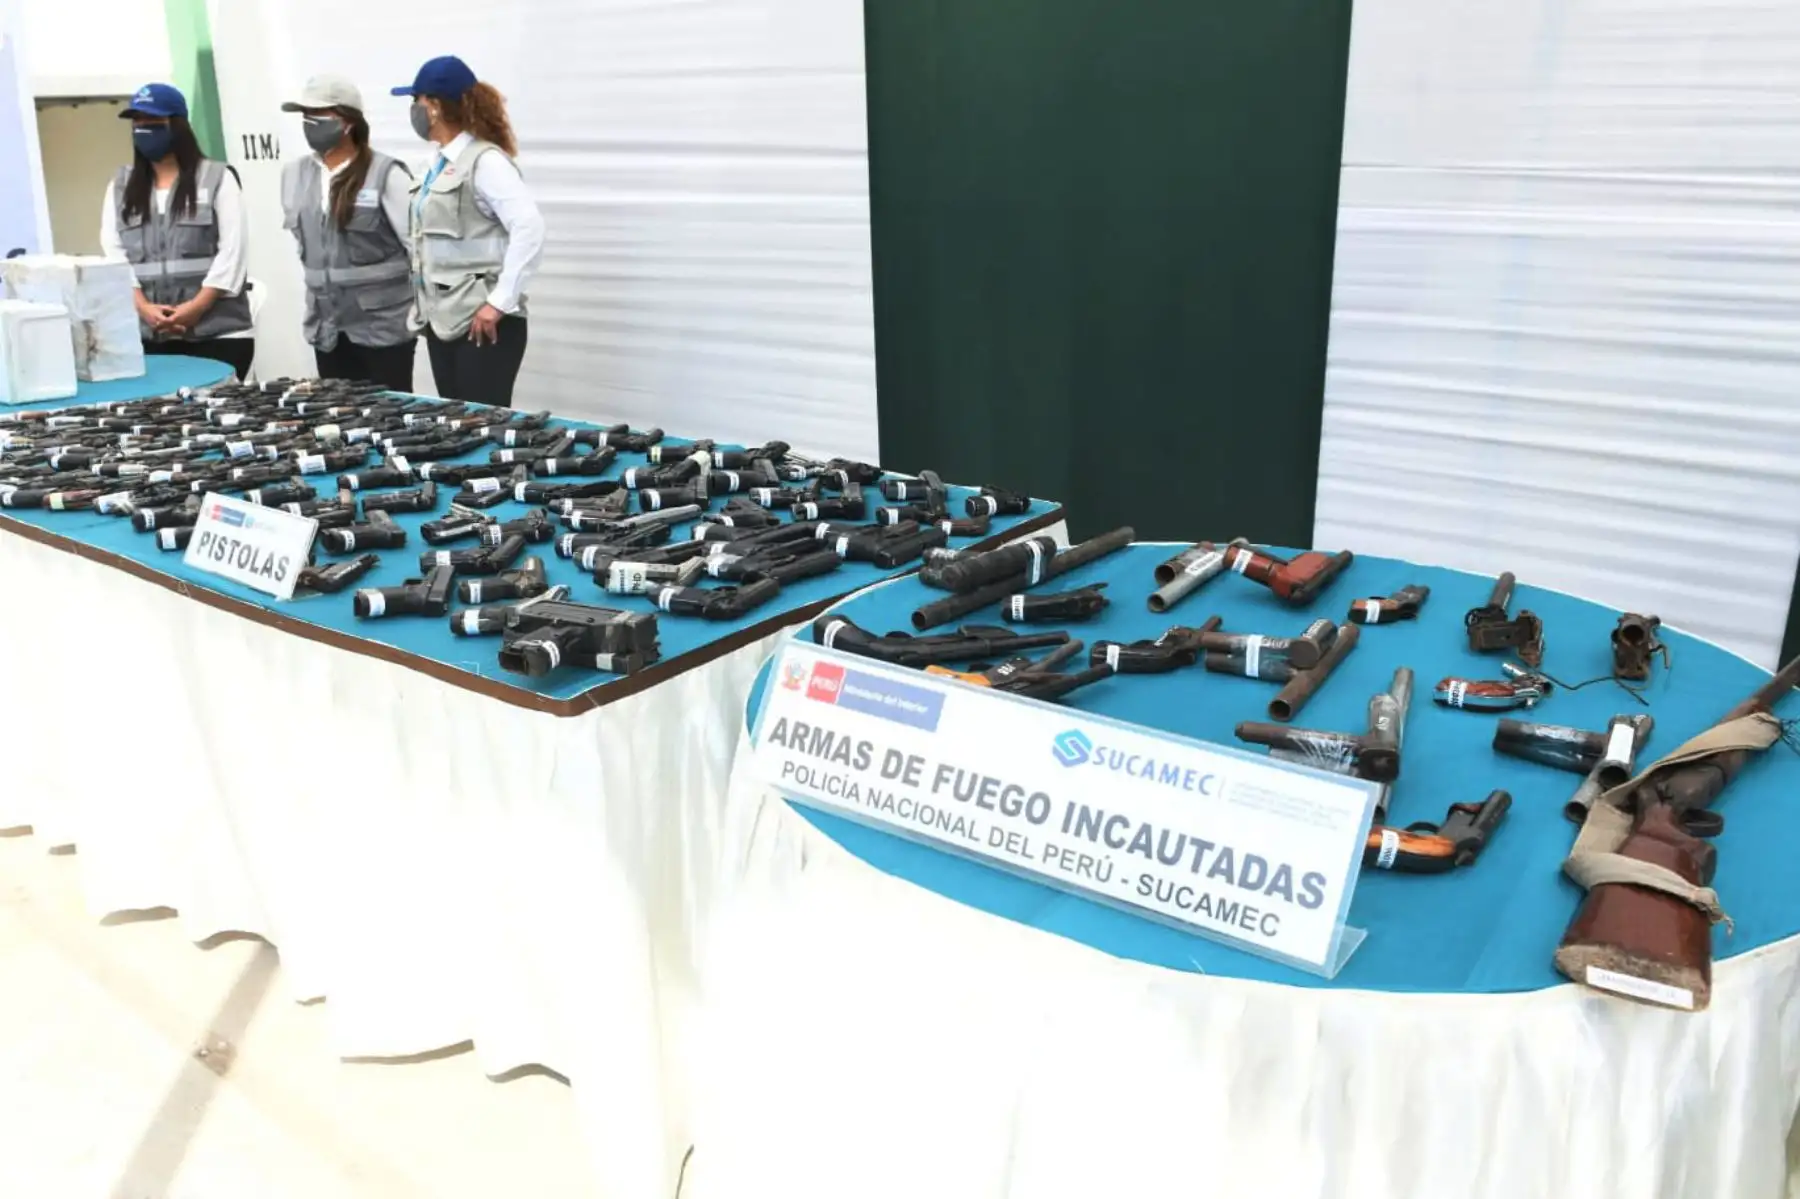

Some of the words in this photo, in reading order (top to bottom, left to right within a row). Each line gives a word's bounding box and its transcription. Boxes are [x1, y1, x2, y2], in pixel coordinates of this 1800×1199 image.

[196, 531, 290, 582] PISTOLAS
[768, 717, 874, 772] ARMAS
[880, 748, 925, 788] DE
[931, 763, 1052, 825] FUEGO
[1061, 800, 1328, 910] INCAUTADAS
[1092, 745, 1216, 796] SUCAMEC
[781, 760, 861, 803] POLICÍA
[866, 787, 981, 842] NACIONAL
[988, 825, 1035, 860] DEL
[1041, 843, 1114, 884] PERÚ
[1136, 873, 1282, 938] SUCAMEC
